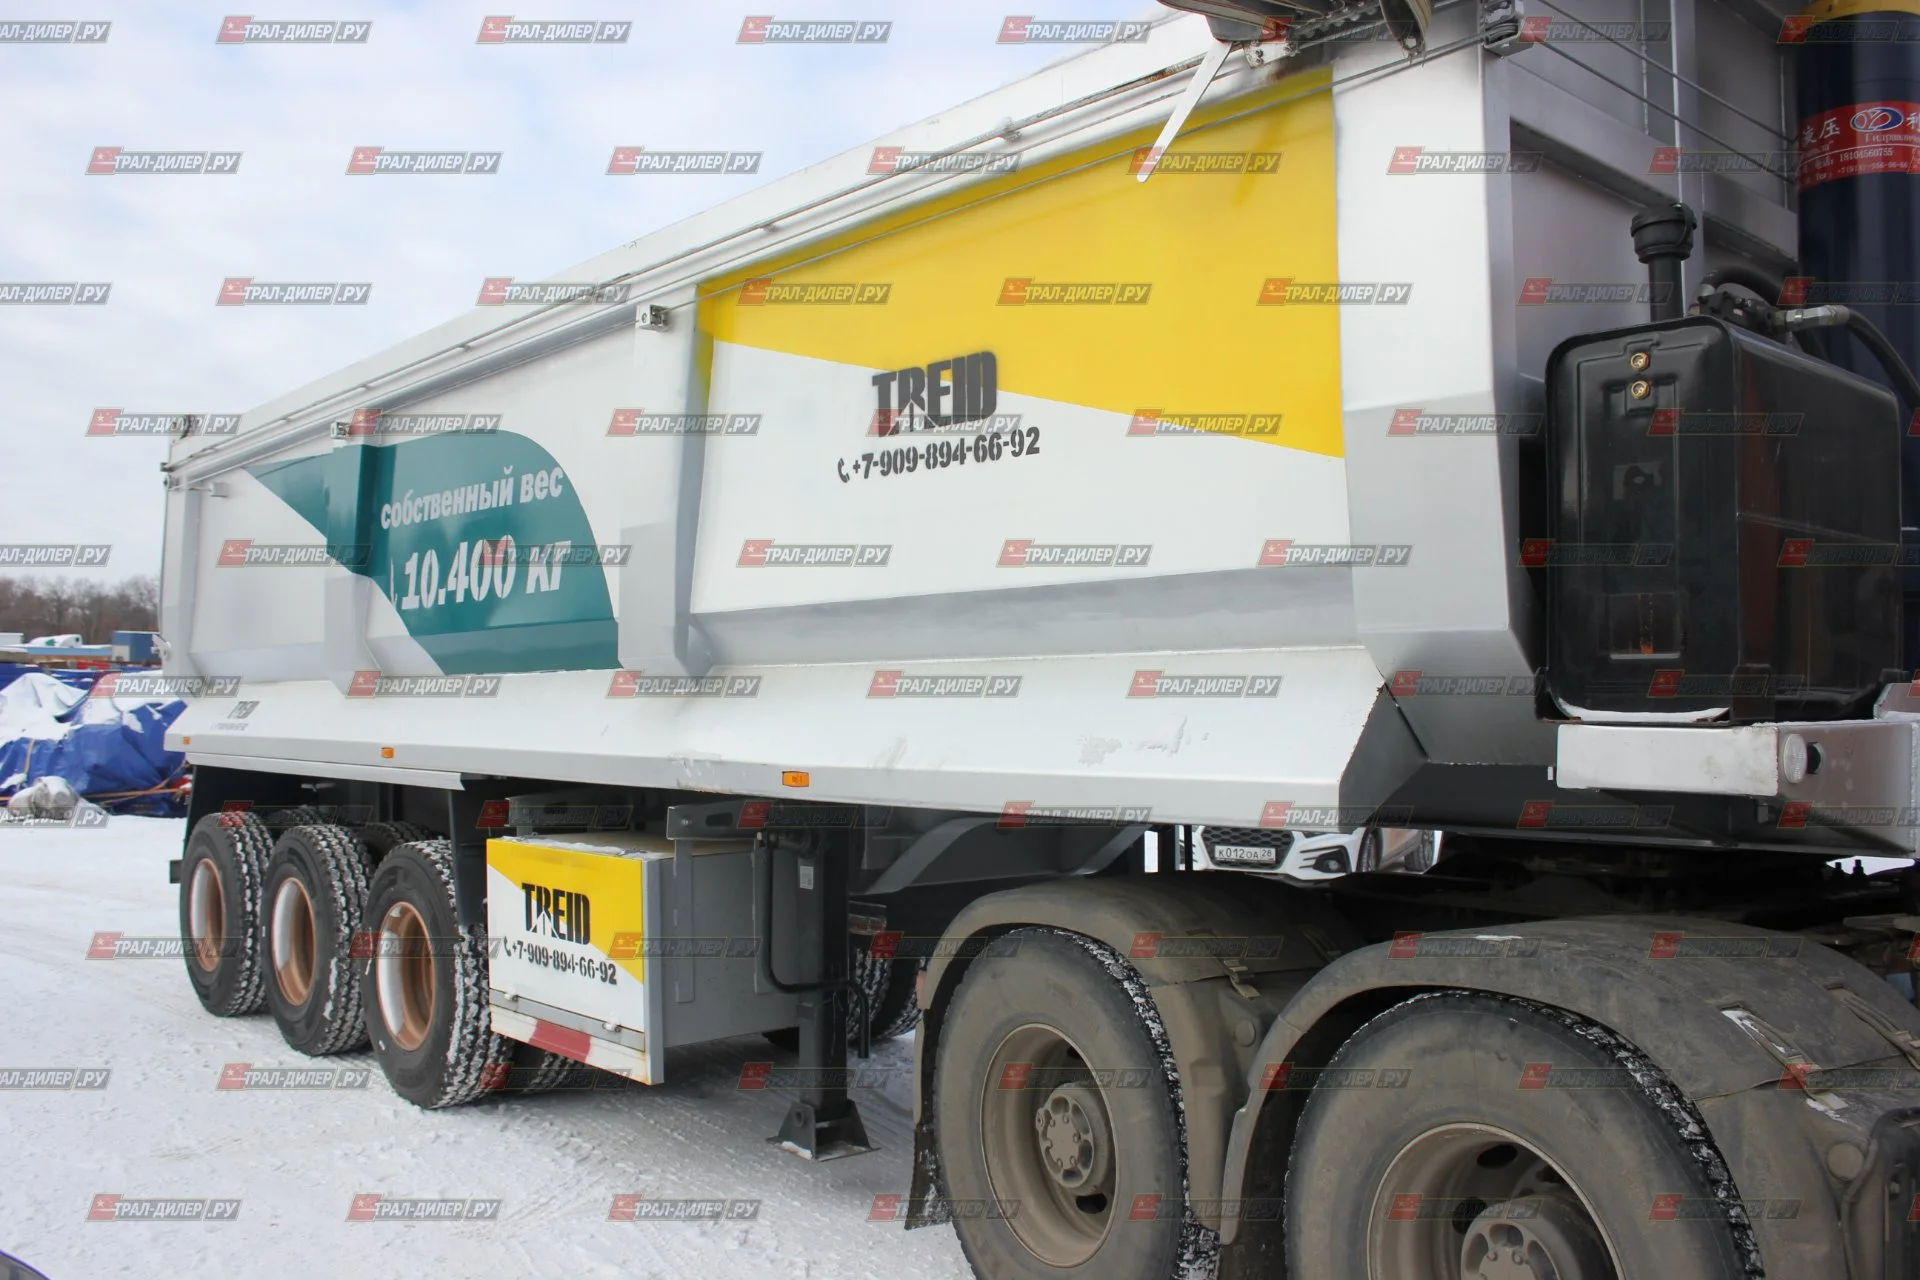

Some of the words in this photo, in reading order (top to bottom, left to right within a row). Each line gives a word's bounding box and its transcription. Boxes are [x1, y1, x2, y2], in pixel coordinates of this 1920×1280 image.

[872, 351, 997, 438] TREID
[853, 426, 1040, 480] +7-909-894-66-92
[381, 465, 514, 530] собственный
[520, 466, 564, 504] вес
[401, 534, 517, 610] 10.400
[522, 882, 590, 945] TREID
[512, 940, 617, 986] +7-909-894-66-92
